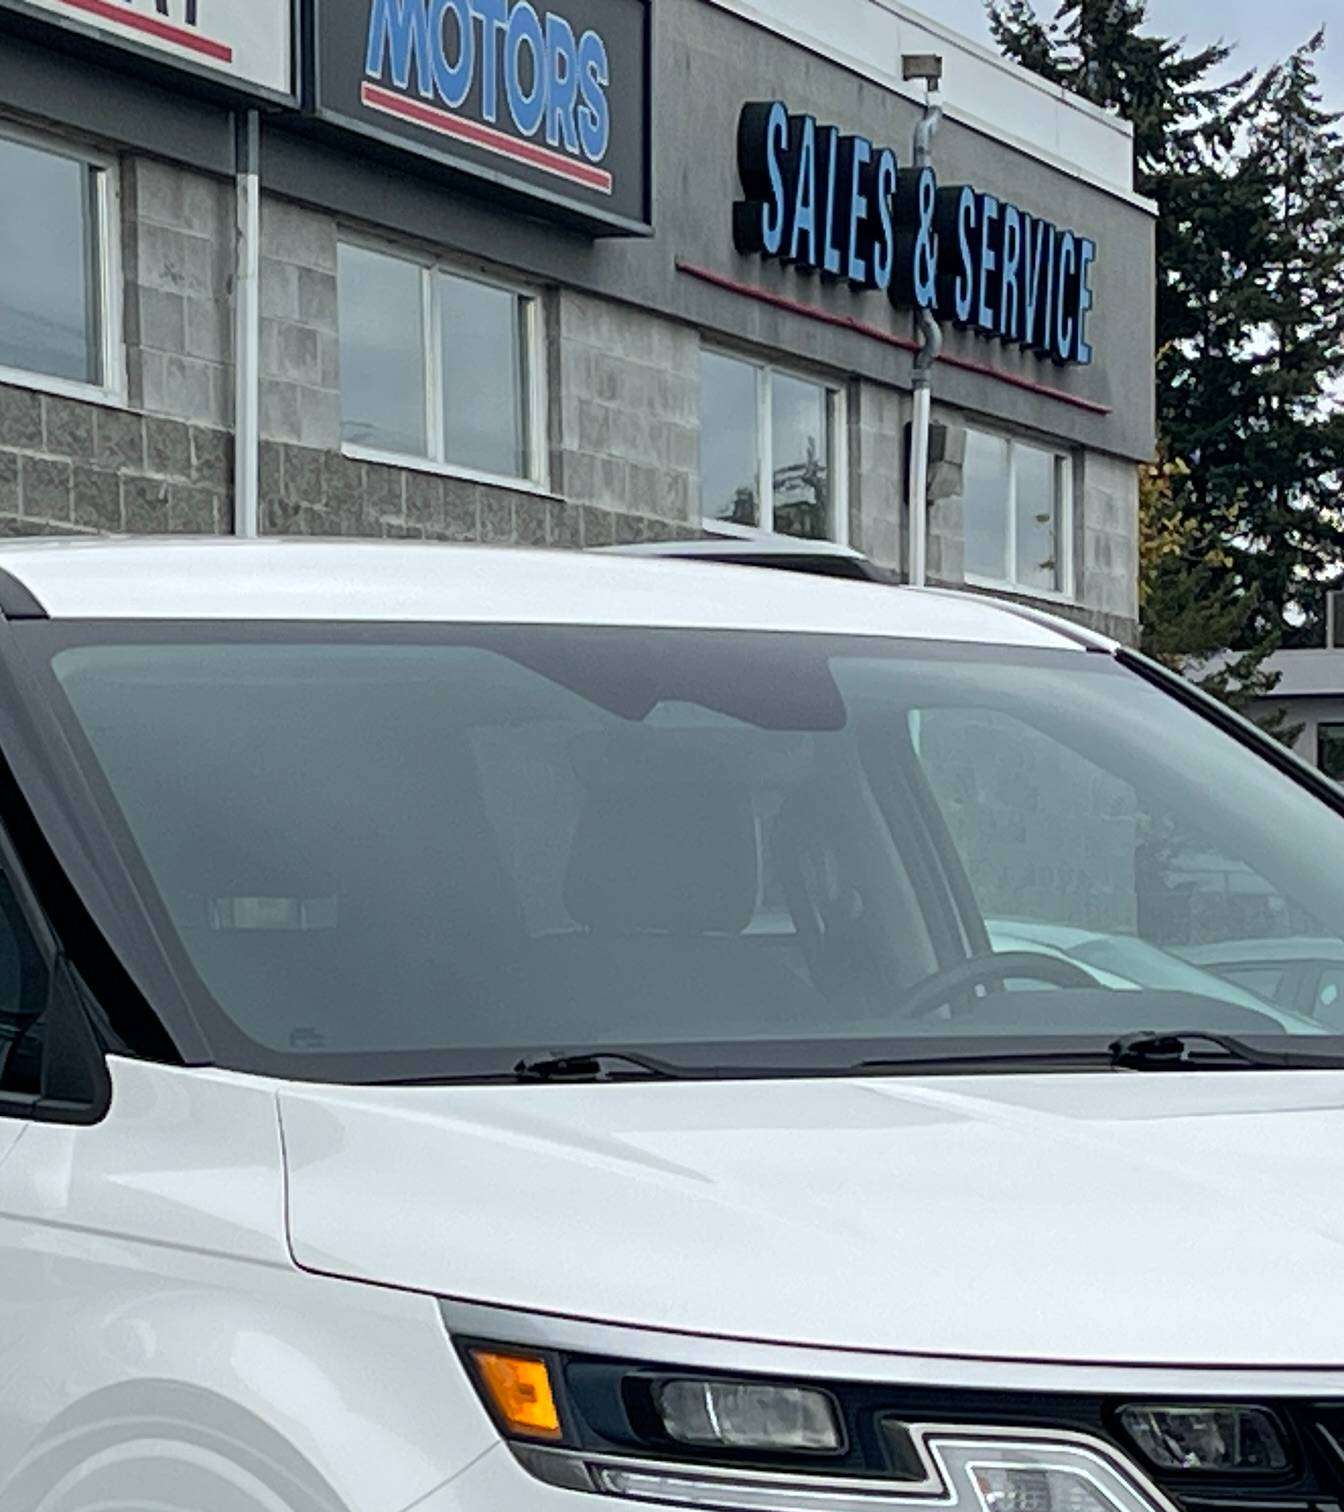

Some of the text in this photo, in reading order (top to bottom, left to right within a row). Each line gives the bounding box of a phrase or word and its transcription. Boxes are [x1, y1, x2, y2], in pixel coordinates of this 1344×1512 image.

[365, 0, 610, 162] MOTORS
[756, 100, 1097, 365] SALES & SERVICE
